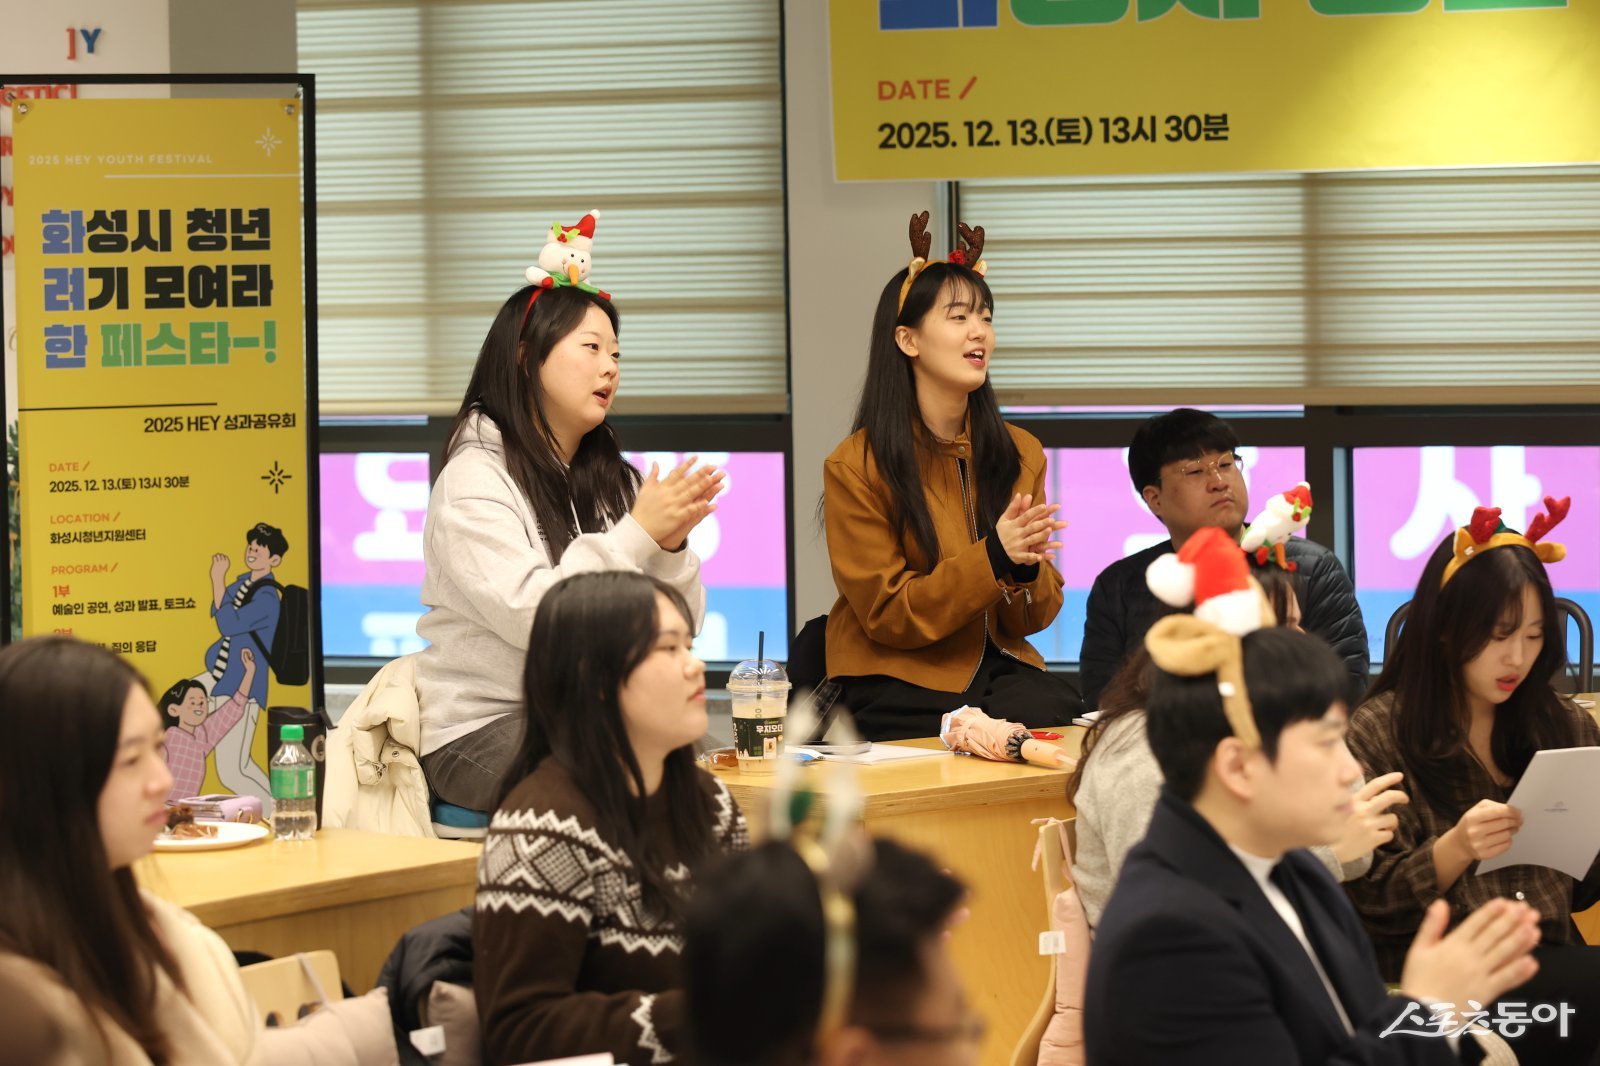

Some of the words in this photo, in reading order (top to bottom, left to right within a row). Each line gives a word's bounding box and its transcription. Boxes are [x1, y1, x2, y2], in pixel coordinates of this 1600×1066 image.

[878, 79, 951, 100] DATE
[878, 121, 957, 149] 2025.
[964, 120, 1000, 148] 12.
[1007, 116, 1093, 147] 13.(토)
[1100, 115, 1157, 144] 13시
[1165, 113, 1229, 142] 30분
[29, 154, 59, 165] 2025
[65, 154, 92, 165] HEY
[97, 153, 144, 165] YOUTH
[150, 153, 213, 164] FESTIVAL
[41, 209, 171, 254] 화성시
[187, 208, 271, 252] 청년
[44, 266, 129, 311] 려기
[144, 264, 273, 309] 모여라
[44, 324, 88, 368] 한
[144, 417, 184, 432] 2025
[187, 415, 220, 431] HEY
[224, 413, 296, 430] 성과공유회
[49, 462, 79, 472] DATE
[50, 480, 82, 493] 2025.
[84, 479, 100, 491] 12.
[102, 478, 137, 491] 13.(토)
[139, 477, 161, 489] 13시
[164, 476, 190, 488] 30분
[50, 513, 110, 525] LOCATION
[50, 529, 146, 544] 화성시청년지원센터
[51, 564, 108, 575] PROGRAM
[52, 584, 70, 598] 1부
[52, 602, 84, 616] 예술인
[87, 601, 111, 614] 공연,
[114, 600, 135, 613] 성과
[164, 597, 196, 610] 토크쇼
[136, 640, 157, 653] 응답
